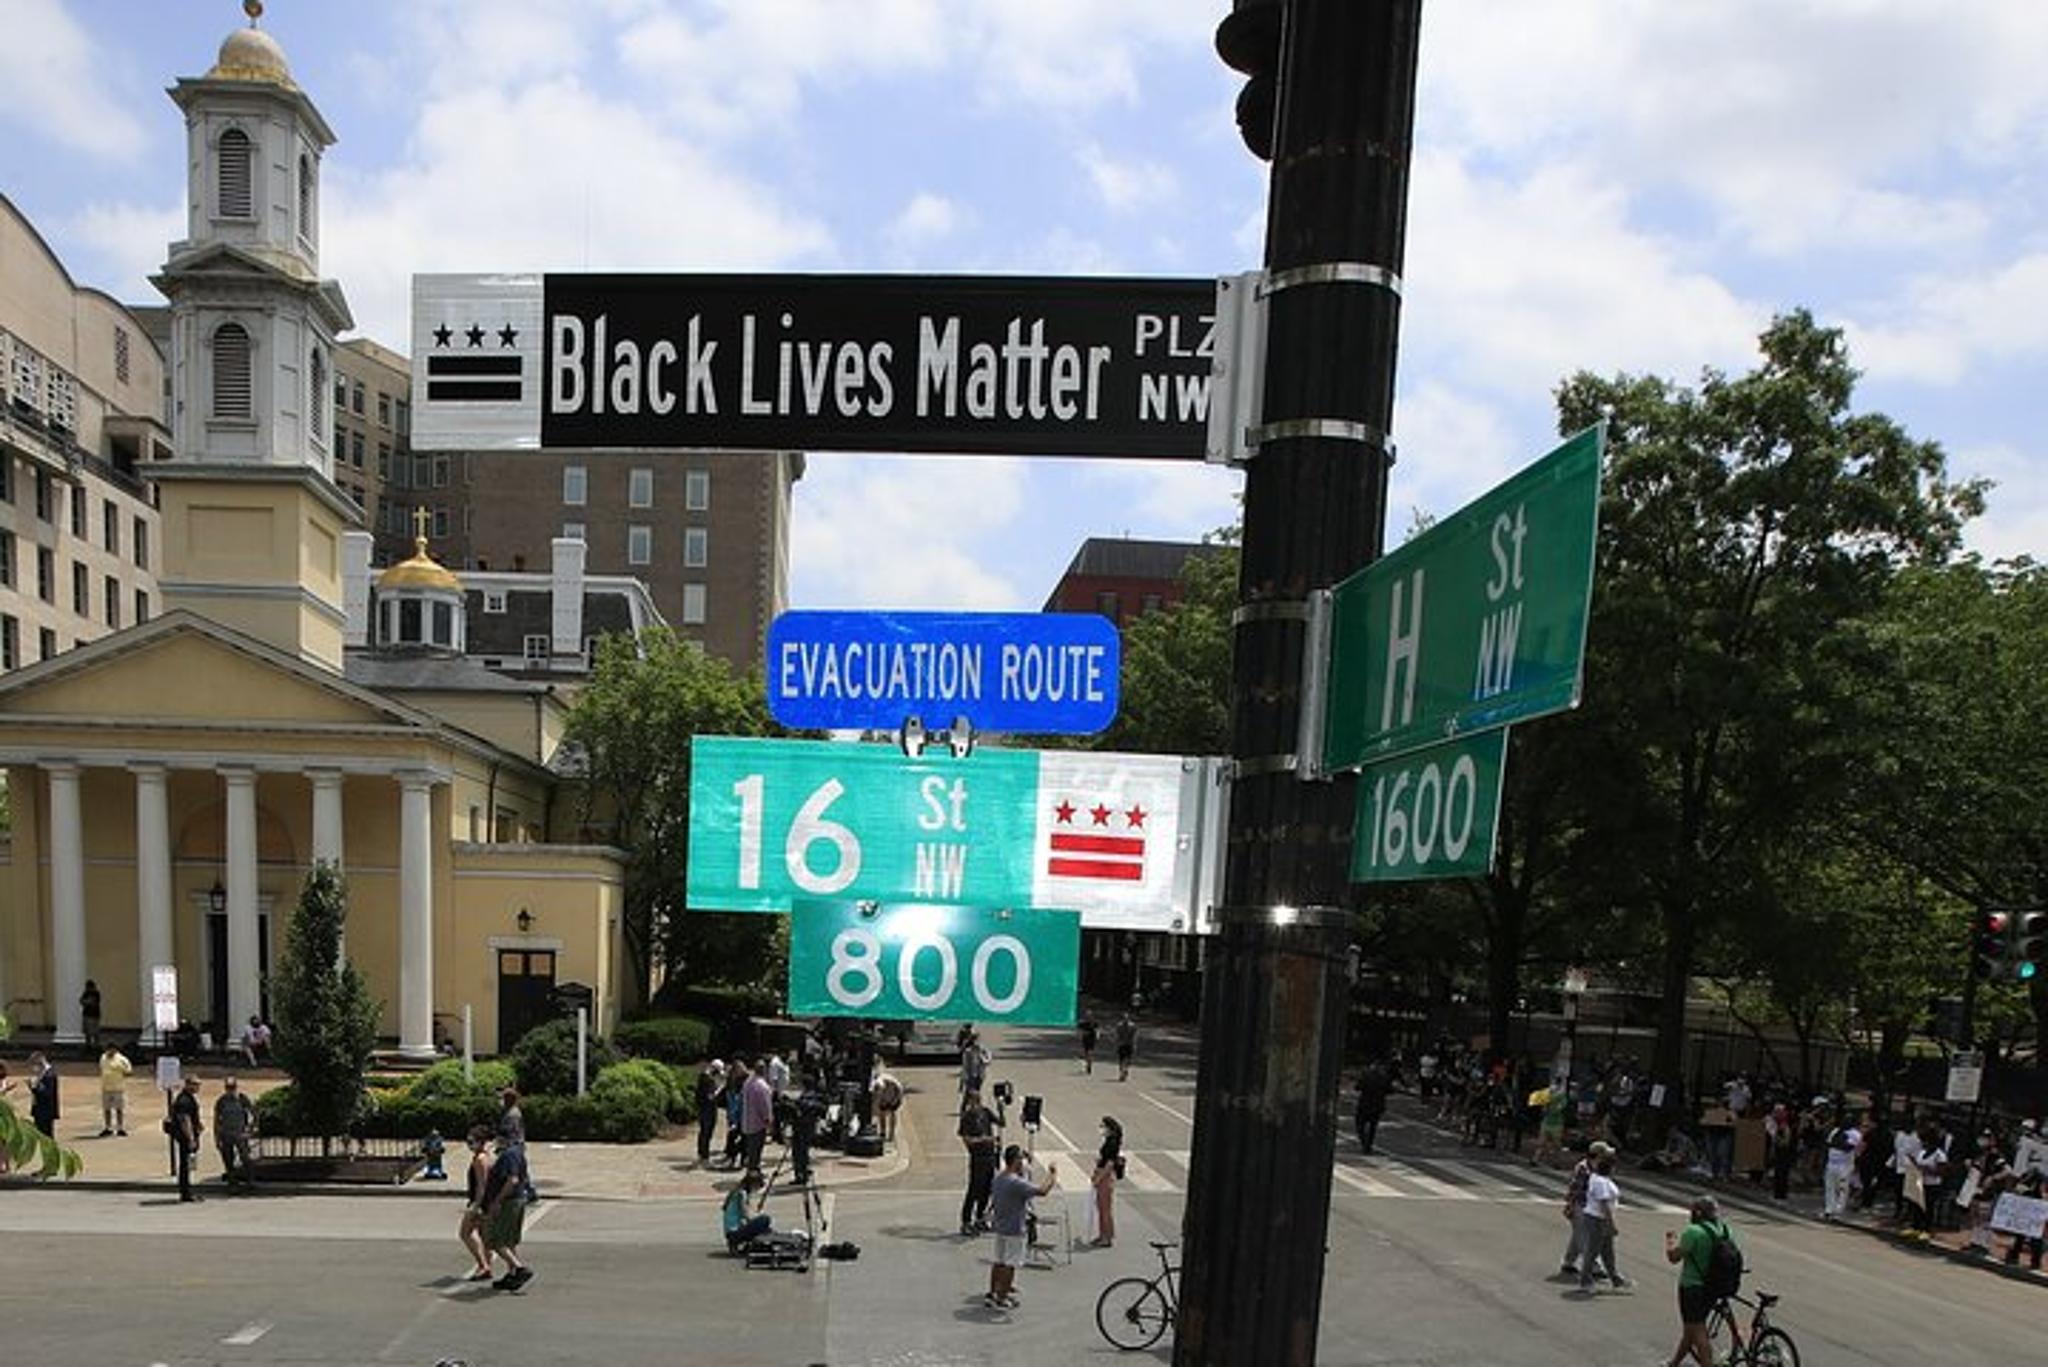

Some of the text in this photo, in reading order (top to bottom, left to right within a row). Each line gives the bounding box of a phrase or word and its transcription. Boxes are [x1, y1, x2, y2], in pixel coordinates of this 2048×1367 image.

[551, 313, 1111, 420] Black Lives Matter
[1136, 315, 1216, 357] PLZ
[1140, 374, 1211, 422] NW
[1488, 503, 1528, 601] St
[781, 643, 1105, 702] EVACUATION ROUTE
[1382, 568, 1424, 731] H
[1475, 602, 1523, 700] NW
[733, 774, 862, 894] 16
[919, 776, 967, 832] St
[1371, 755, 1477, 867] 1600
[915, 842, 967, 899] NW
[825, 927, 1032, 1014] 800
